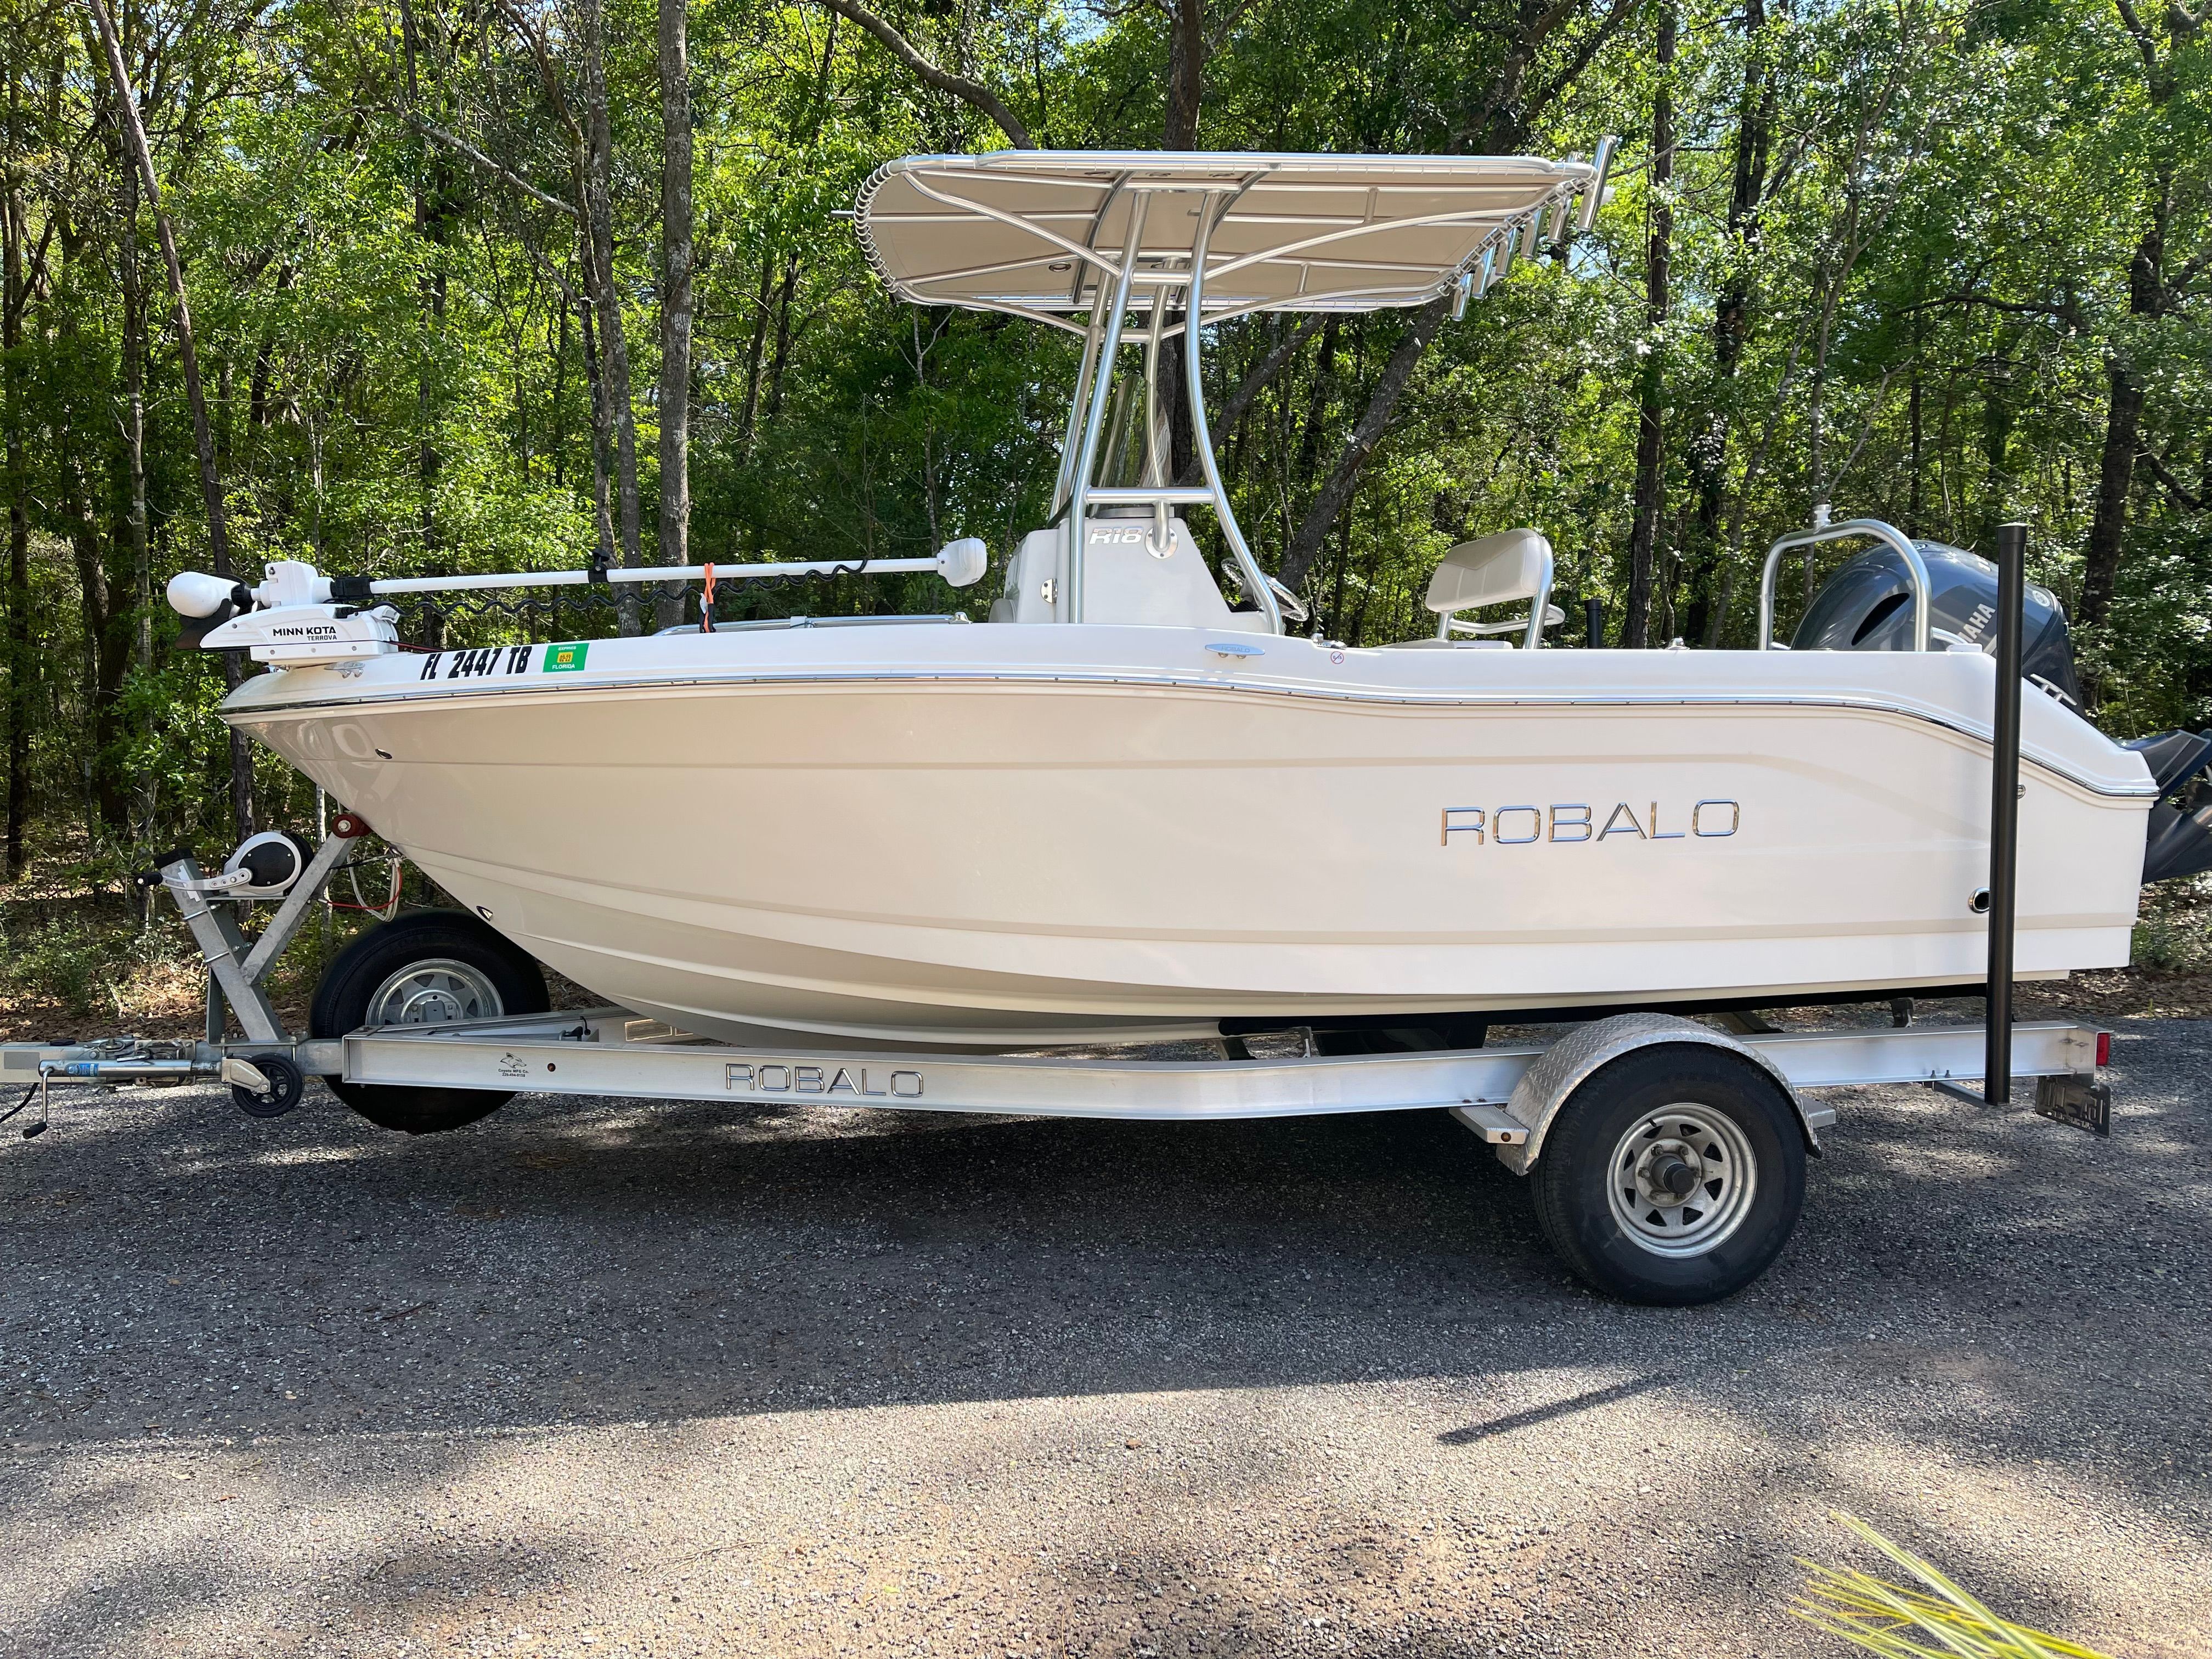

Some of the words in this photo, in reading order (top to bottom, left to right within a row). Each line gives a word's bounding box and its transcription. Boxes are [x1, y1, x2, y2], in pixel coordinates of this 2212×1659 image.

[1089, 527, 1143, 544] R18
[273, 628, 303, 636] MINN
[306, 627, 336, 635] KOTA
[420, 653, 442, 680] FL
[447, 647, 503, 679] 2447
[506, 646, 533, 674] TB
[1441, 799, 1740, 846] ROBALO
[725, 1063, 924, 1098] ROBALO
